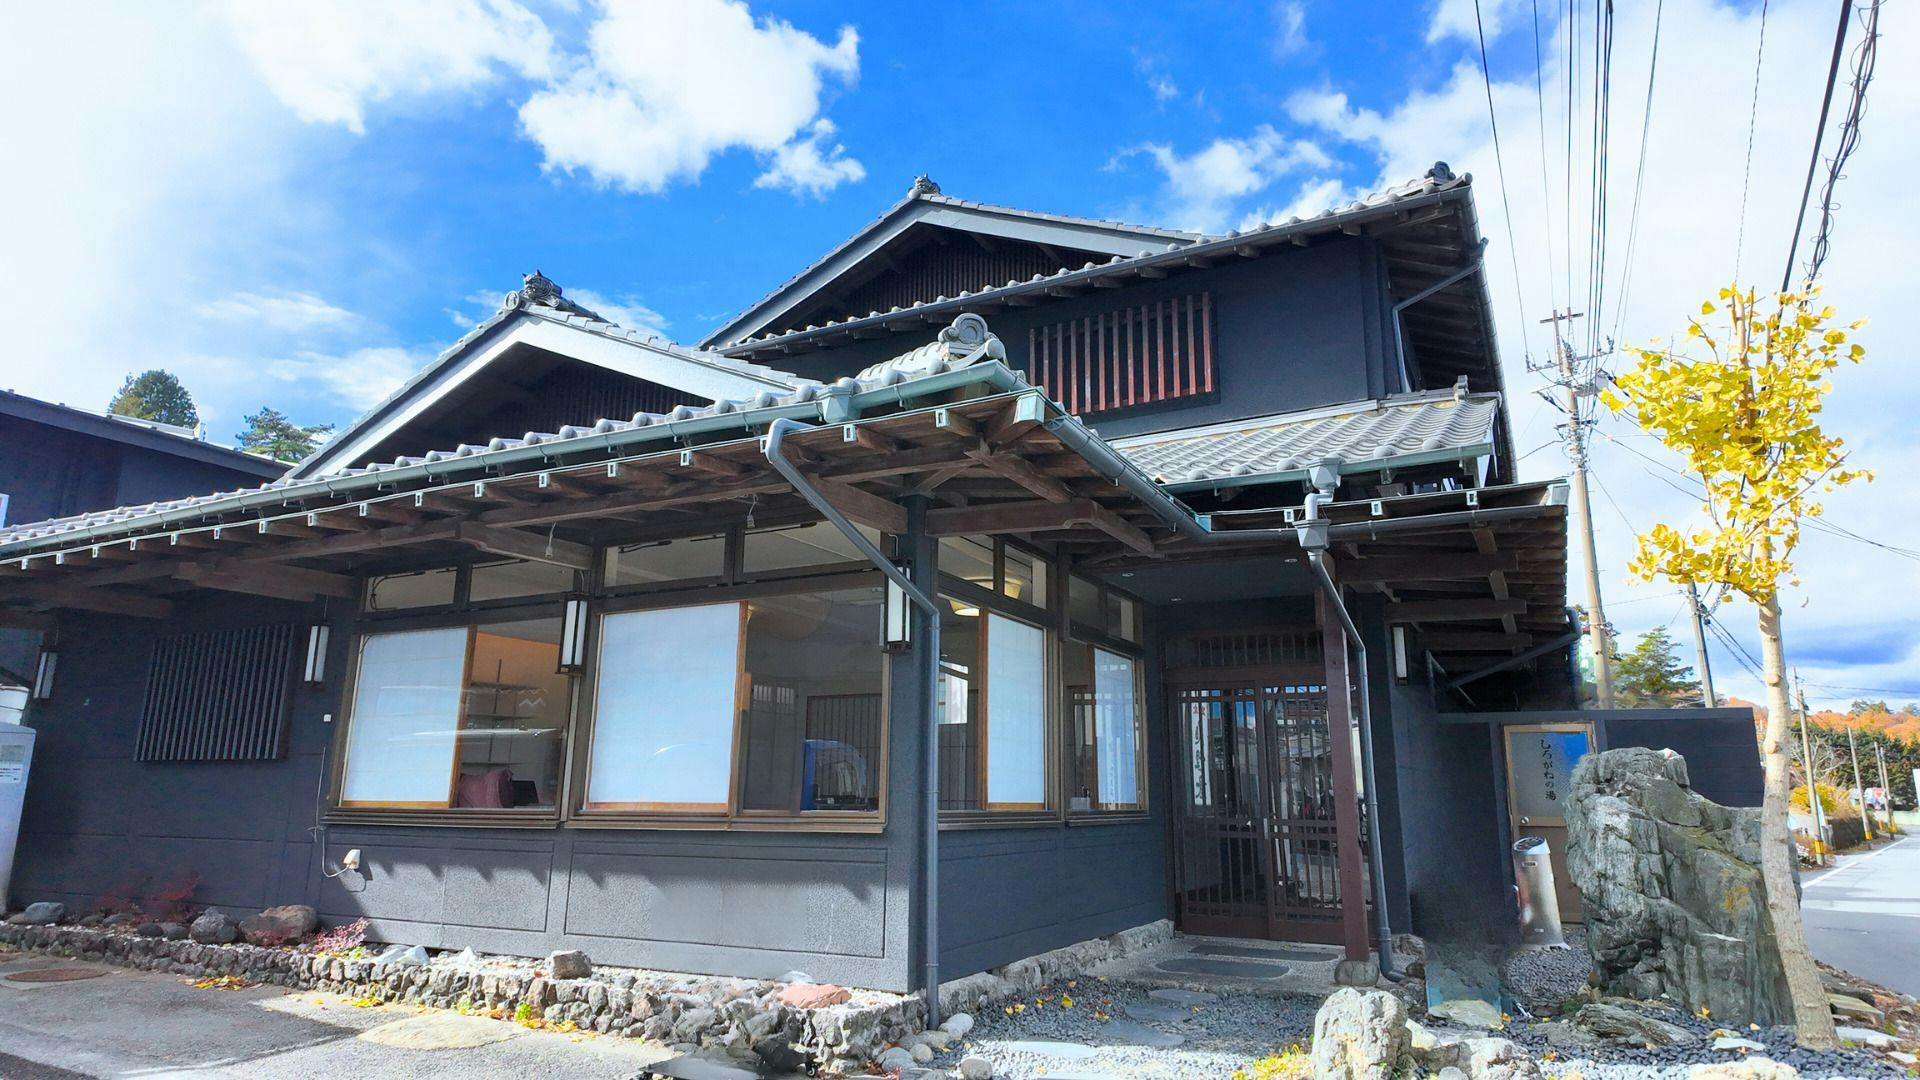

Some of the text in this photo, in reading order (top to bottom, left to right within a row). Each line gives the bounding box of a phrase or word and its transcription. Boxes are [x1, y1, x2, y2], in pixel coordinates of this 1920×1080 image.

[1540, 739, 1557, 801] しろがねの湯
